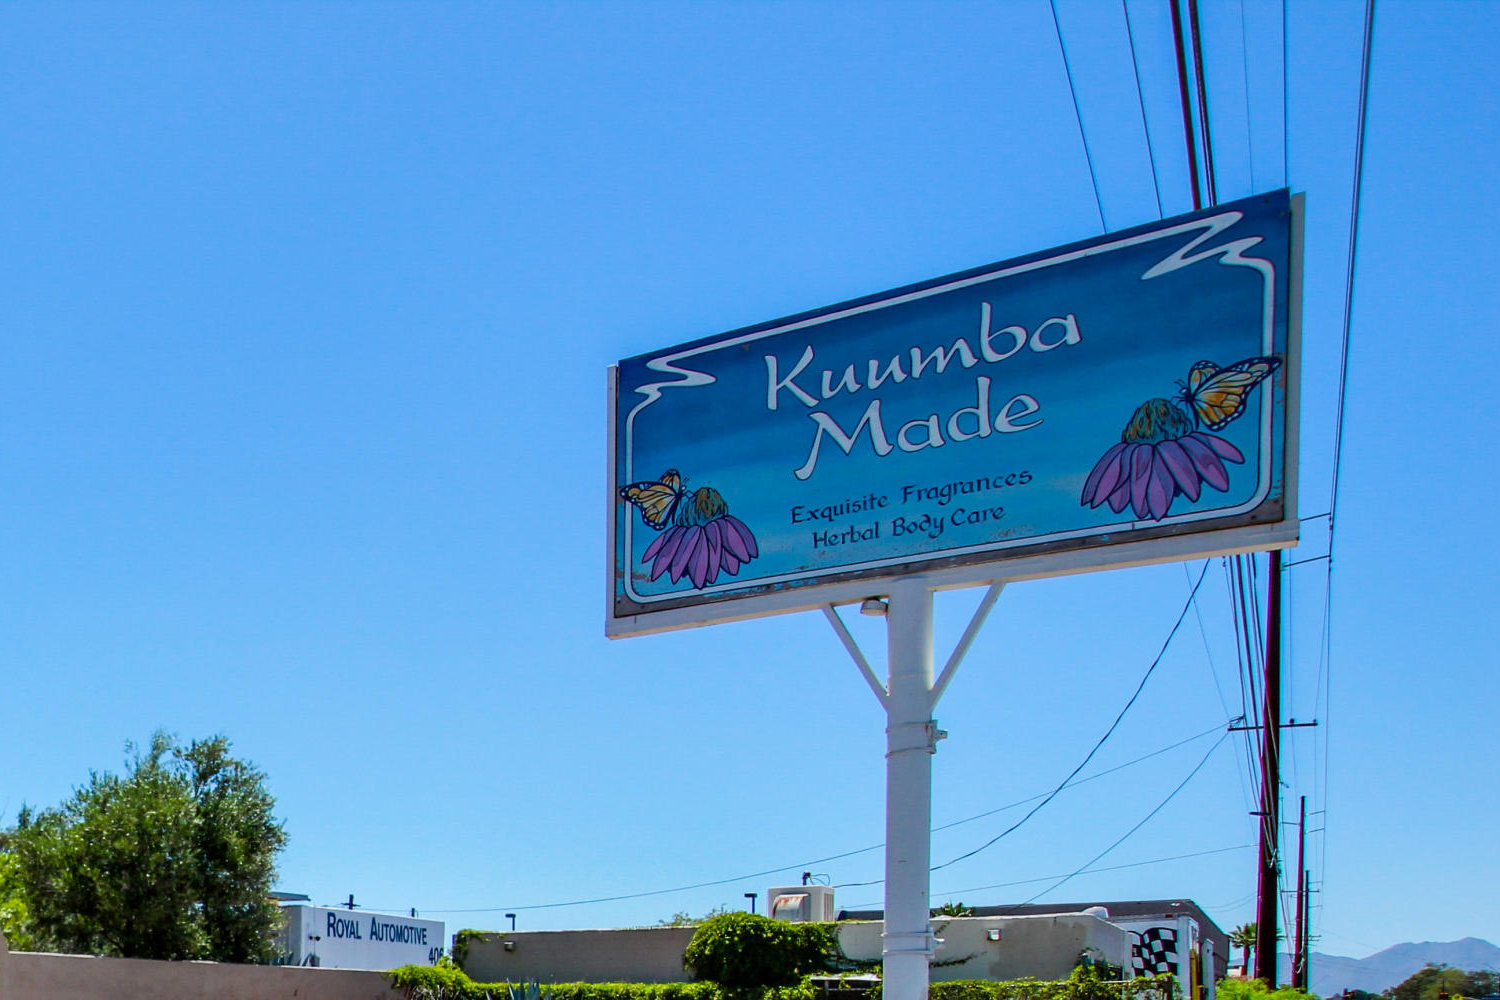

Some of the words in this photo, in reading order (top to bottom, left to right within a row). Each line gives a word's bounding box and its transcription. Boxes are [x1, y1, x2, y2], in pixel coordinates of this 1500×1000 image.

[764, 301, 1082, 411] Kuumba
[793, 376, 1044, 481] Made
[791, 493, 889, 524] Exquisite
[901, 469, 1033, 506] Fragrances
[812, 521, 880, 549] Herbal
[892, 513, 945, 539] Body
[950, 506, 1006, 527] Care
[327, 912, 362, 940] ROYAL
[370, 916, 428, 945] AUTOMOTIVE
